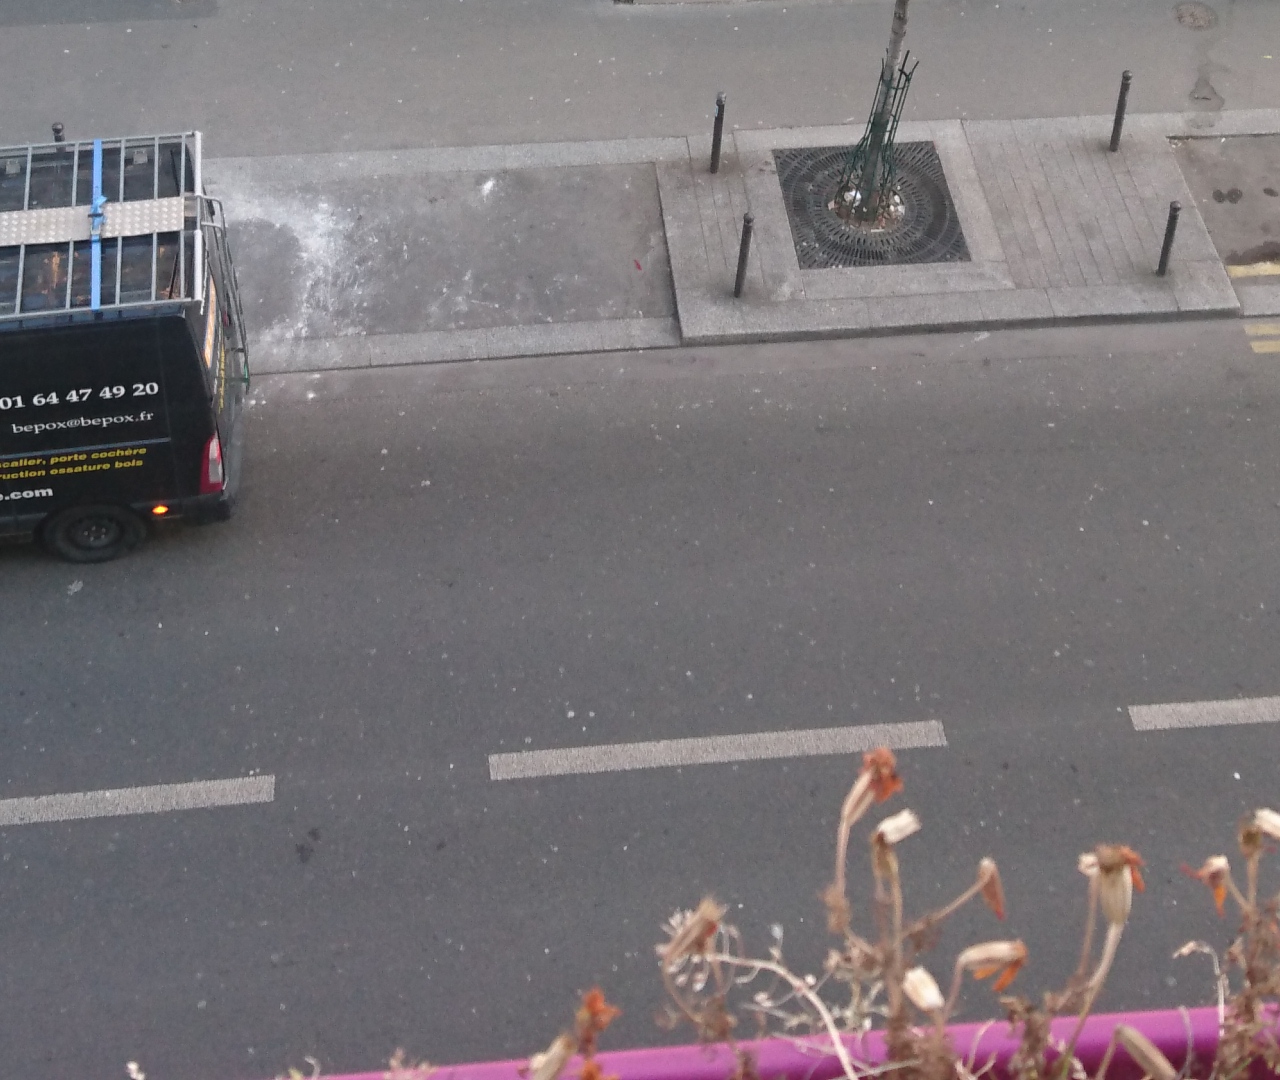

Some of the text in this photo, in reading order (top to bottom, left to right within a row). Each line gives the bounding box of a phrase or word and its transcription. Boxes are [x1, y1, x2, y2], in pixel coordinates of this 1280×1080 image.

[32, 391, 60, 407] 64
[65, 388, 93, 403] 47
[99, 385, 126, 400] 49
[132, 381, 159, 397] 20
[11, 411, 155, 435] bepox@bepox.fr
[49, 462, 111, 476] ossature
[114, 458, 144, 468] bois
[50, 453, 87, 466] porte
[91, 447, 147, 459] cochère
